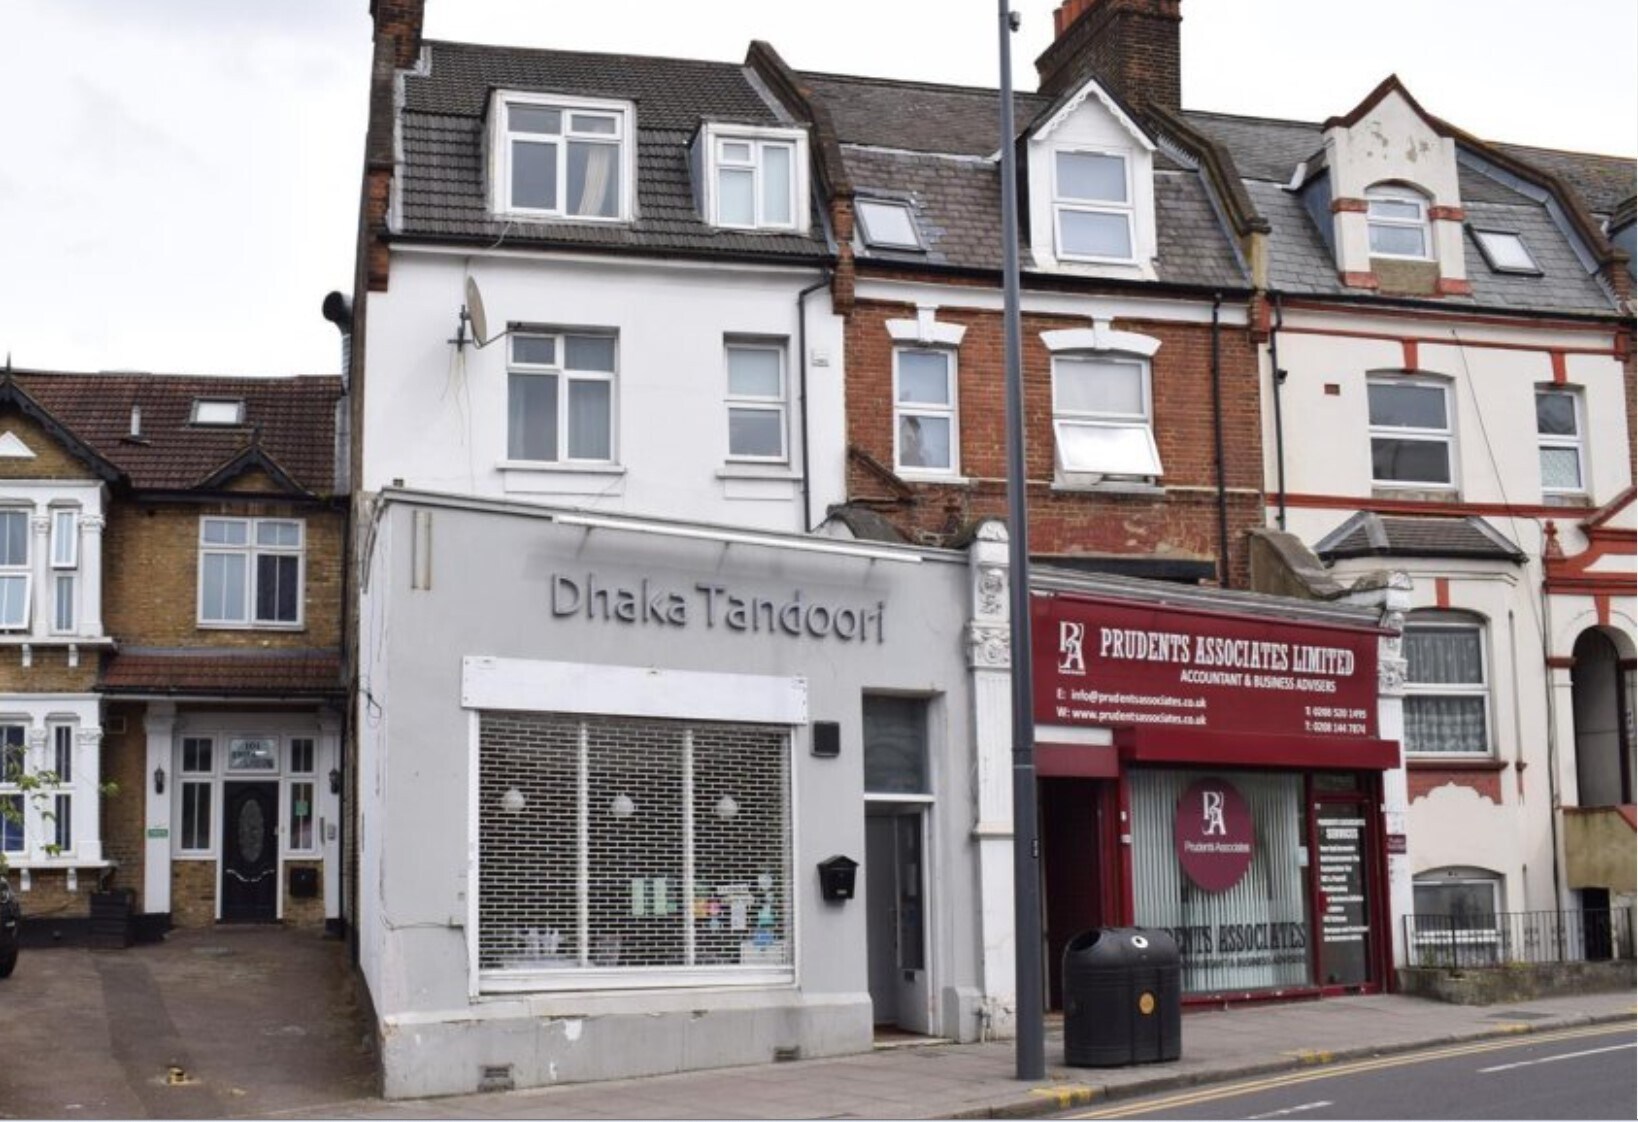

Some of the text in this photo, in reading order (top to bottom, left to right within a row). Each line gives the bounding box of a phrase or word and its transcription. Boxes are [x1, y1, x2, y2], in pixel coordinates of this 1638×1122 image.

[551, 573, 885, 645] Dhaka Tandoori
[1100, 628, 1355, 676] PRUDENTS ASSOCIATES LIMITED
[1180, 669, 1337, 694] ACCOUNTANT & BUSINESS ADVISERS
[1056, 687, 1207, 708] E: info@prudentsassociates.co.uk
[1056, 705, 1207, 725] W: www.prudentsassociates.co.uk
[1184, 840, 1250, 854] Prudents Associates
